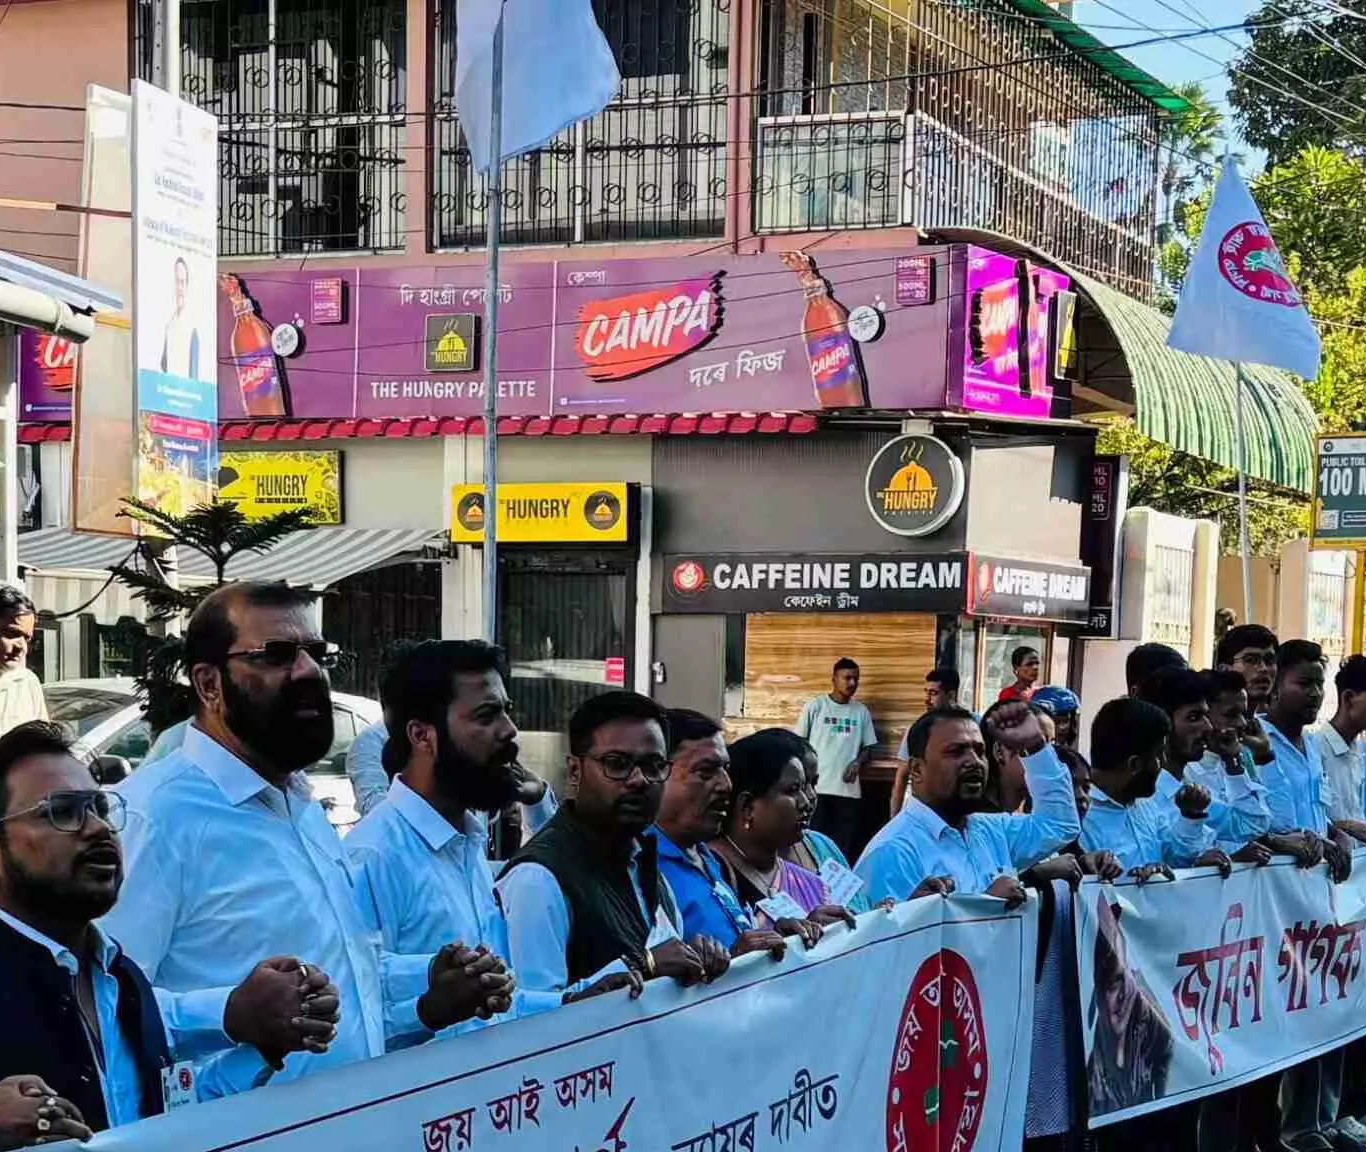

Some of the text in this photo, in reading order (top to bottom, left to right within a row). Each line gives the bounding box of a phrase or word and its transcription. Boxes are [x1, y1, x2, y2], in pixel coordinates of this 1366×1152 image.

[583, 289, 713, 357] CAMPA
[371, 380, 536, 398] THE HUNGRY PAETTE
[1321, 457, 1349, 467] PUBLIC
[256, 474, 308, 496] HUNGRY
[1319, 467, 1353, 496] 100
[506, 497, 571, 520] HUNGRY
[883, 489, 938, 511] HUNGRY
[712, 561, 962, 590] CAFFEINE DREAM
[486, 1075, 545, 1135] আই
[553, 1061, 616, 1111] অসম
[769, 1068, 840, 1145] দাবীত
